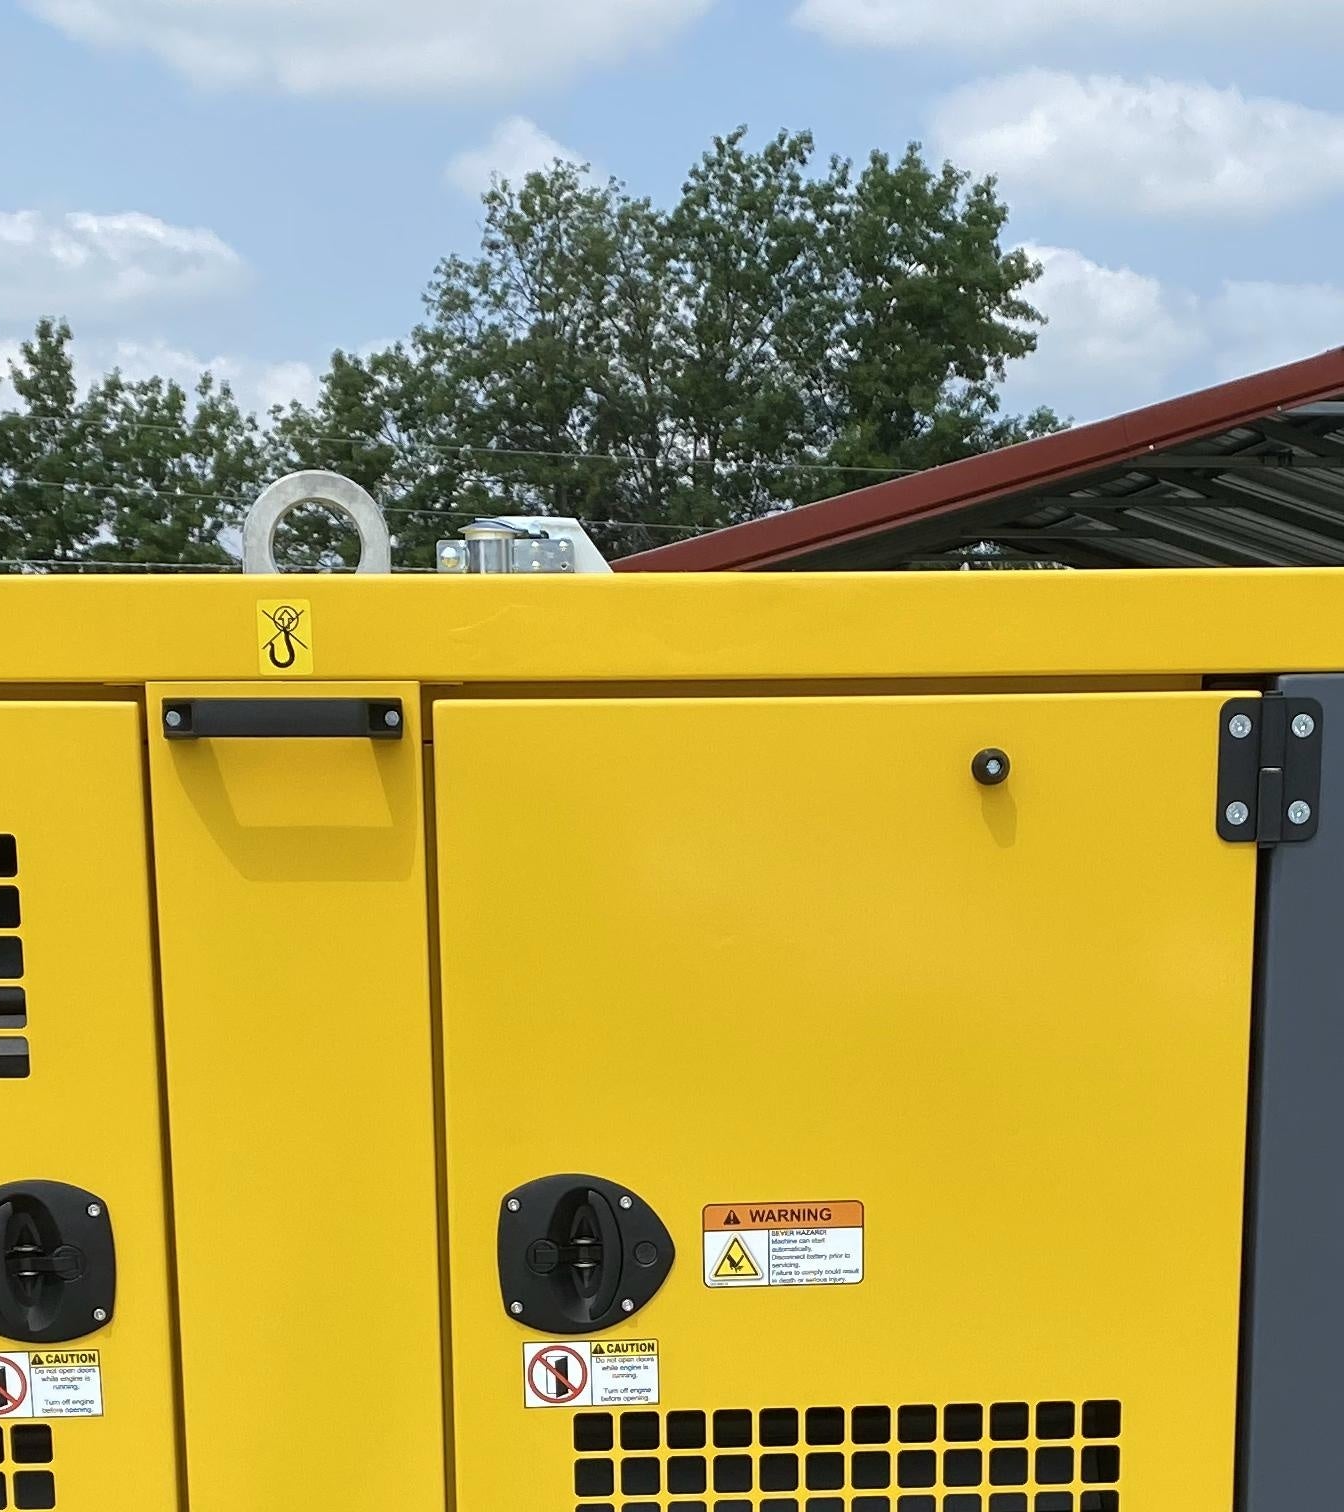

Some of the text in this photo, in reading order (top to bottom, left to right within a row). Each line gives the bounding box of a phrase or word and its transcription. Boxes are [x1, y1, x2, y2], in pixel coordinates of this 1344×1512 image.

[749, 1207, 833, 1223] WARNING
[606, 1343, 655, 1354] CAUTION
[45, 1353, 96, 1365] CAUTION
